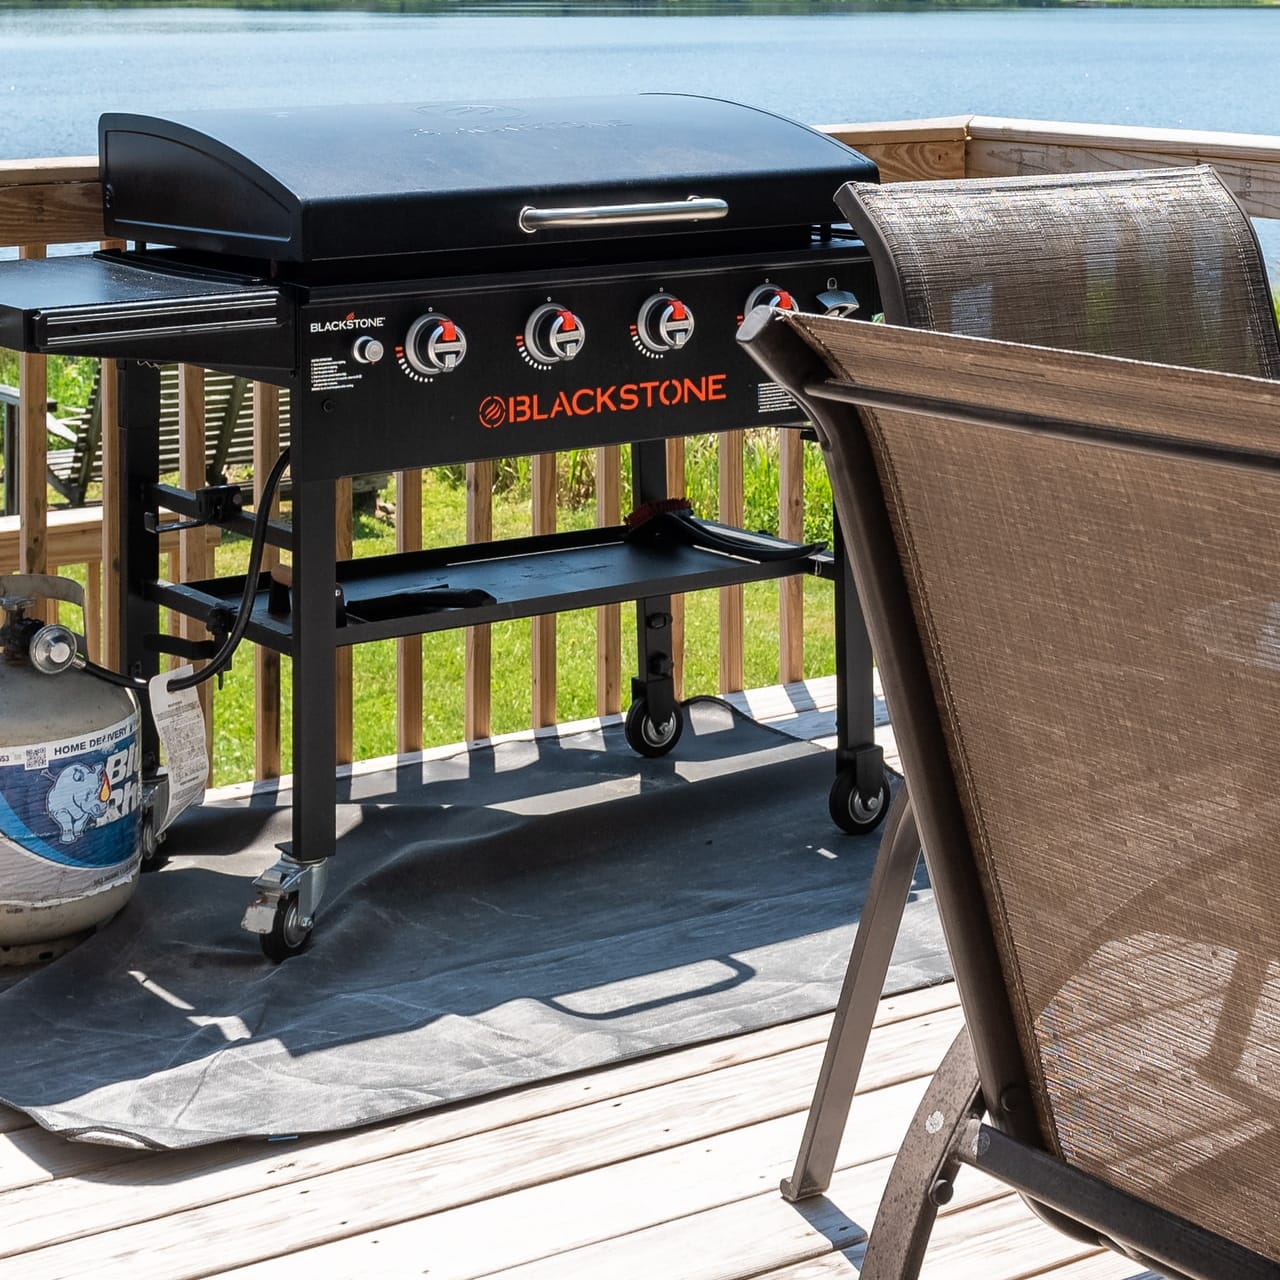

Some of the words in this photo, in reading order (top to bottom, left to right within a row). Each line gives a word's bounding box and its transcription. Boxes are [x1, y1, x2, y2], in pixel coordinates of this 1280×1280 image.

[310, 317, 384, 332] BLACKSTONE
[509, 374, 726, 423] BLACKSTONE
[54, 741, 86, 755] HOME
